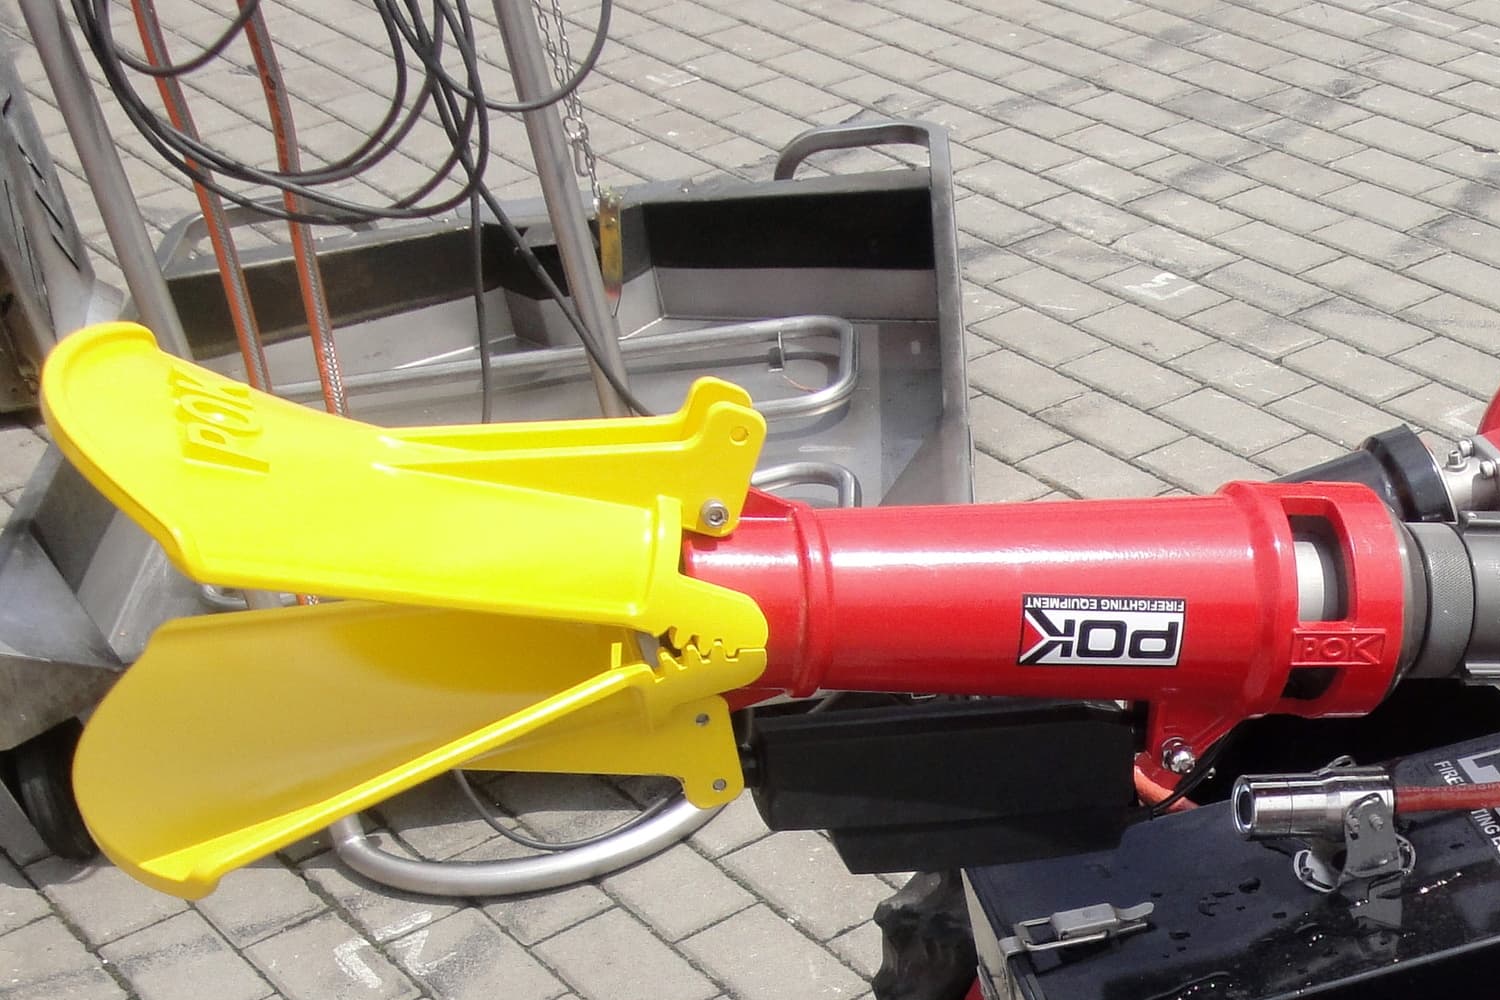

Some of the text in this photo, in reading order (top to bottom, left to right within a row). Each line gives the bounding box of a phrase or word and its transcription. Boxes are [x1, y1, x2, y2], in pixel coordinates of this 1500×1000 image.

[172, 368, 272, 472] POK
[1025, 596, 1185, 612] FIREFIGHTING EQUIPMENT
[1020, 609, 1178, 665] POK
[1303, 634, 1381, 662] POK
[1434, 759, 1500, 836] FIRETING
